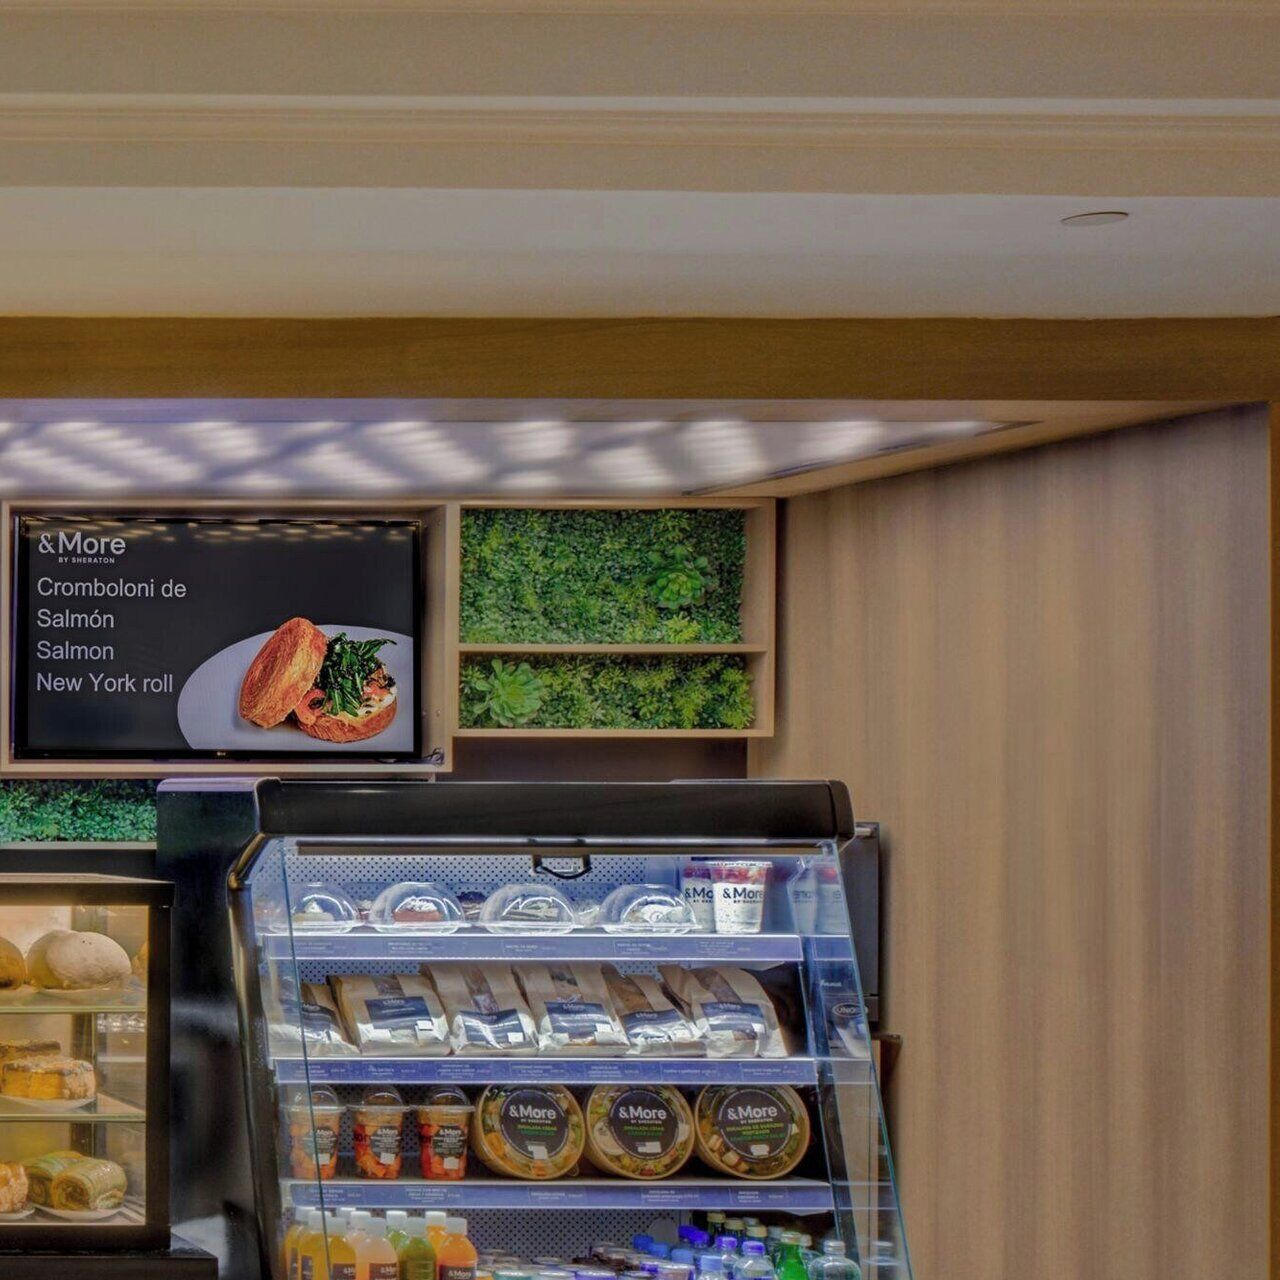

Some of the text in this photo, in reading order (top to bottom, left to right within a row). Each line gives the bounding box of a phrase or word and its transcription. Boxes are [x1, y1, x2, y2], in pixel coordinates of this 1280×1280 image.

[39, 531, 126, 555] &More
[58, 556, 115, 564] BY SHERATON
[37, 577, 187, 598] Cromboloni de
[36, 608, 115, 629] Salmón
[36, 640, 114, 660] Salmon
[36, 672, 173, 693] New York roll
[684, 886, 714, 899] &Mo
[508, 1103, 557, 1120] &More
[618, 1104, 667, 1120] &More
[727, 1105, 778, 1120] &More
